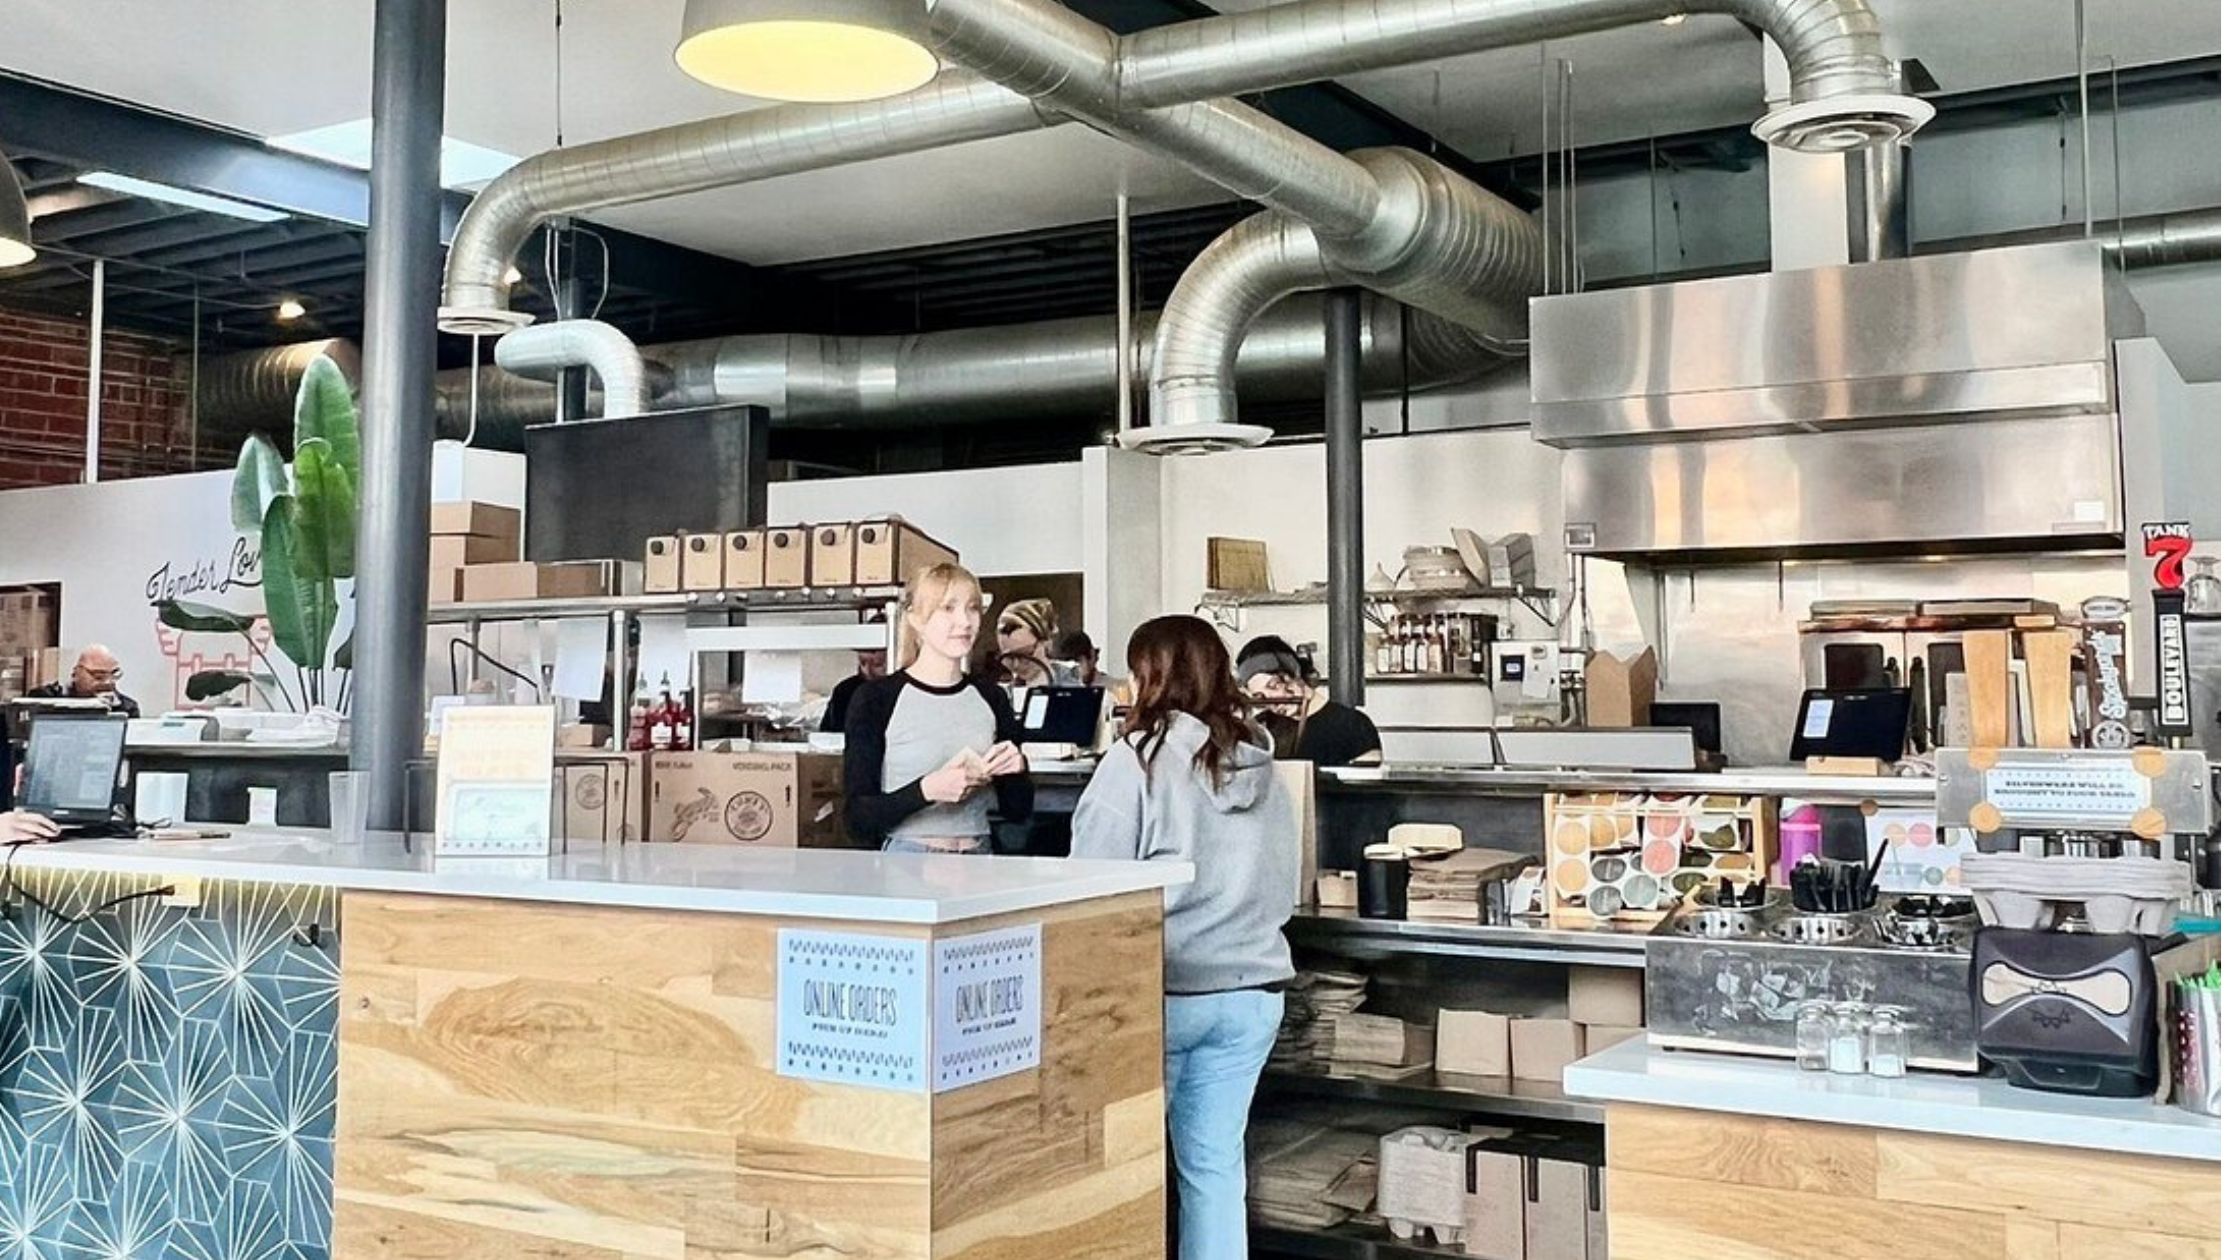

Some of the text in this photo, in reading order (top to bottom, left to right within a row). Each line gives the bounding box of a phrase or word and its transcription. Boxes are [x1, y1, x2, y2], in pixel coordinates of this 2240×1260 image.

[2143, 524, 2190, 539] TANK
[219, 537, 262, 594] Lov
[2145, 536, 2193, 590] 7
[2162, 614, 2185, 722] BOULEVARD
[803, 979, 897, 1026] ONLINE ORDERS
[956, 974, 1024, 1023] ONLINE ORDERS
